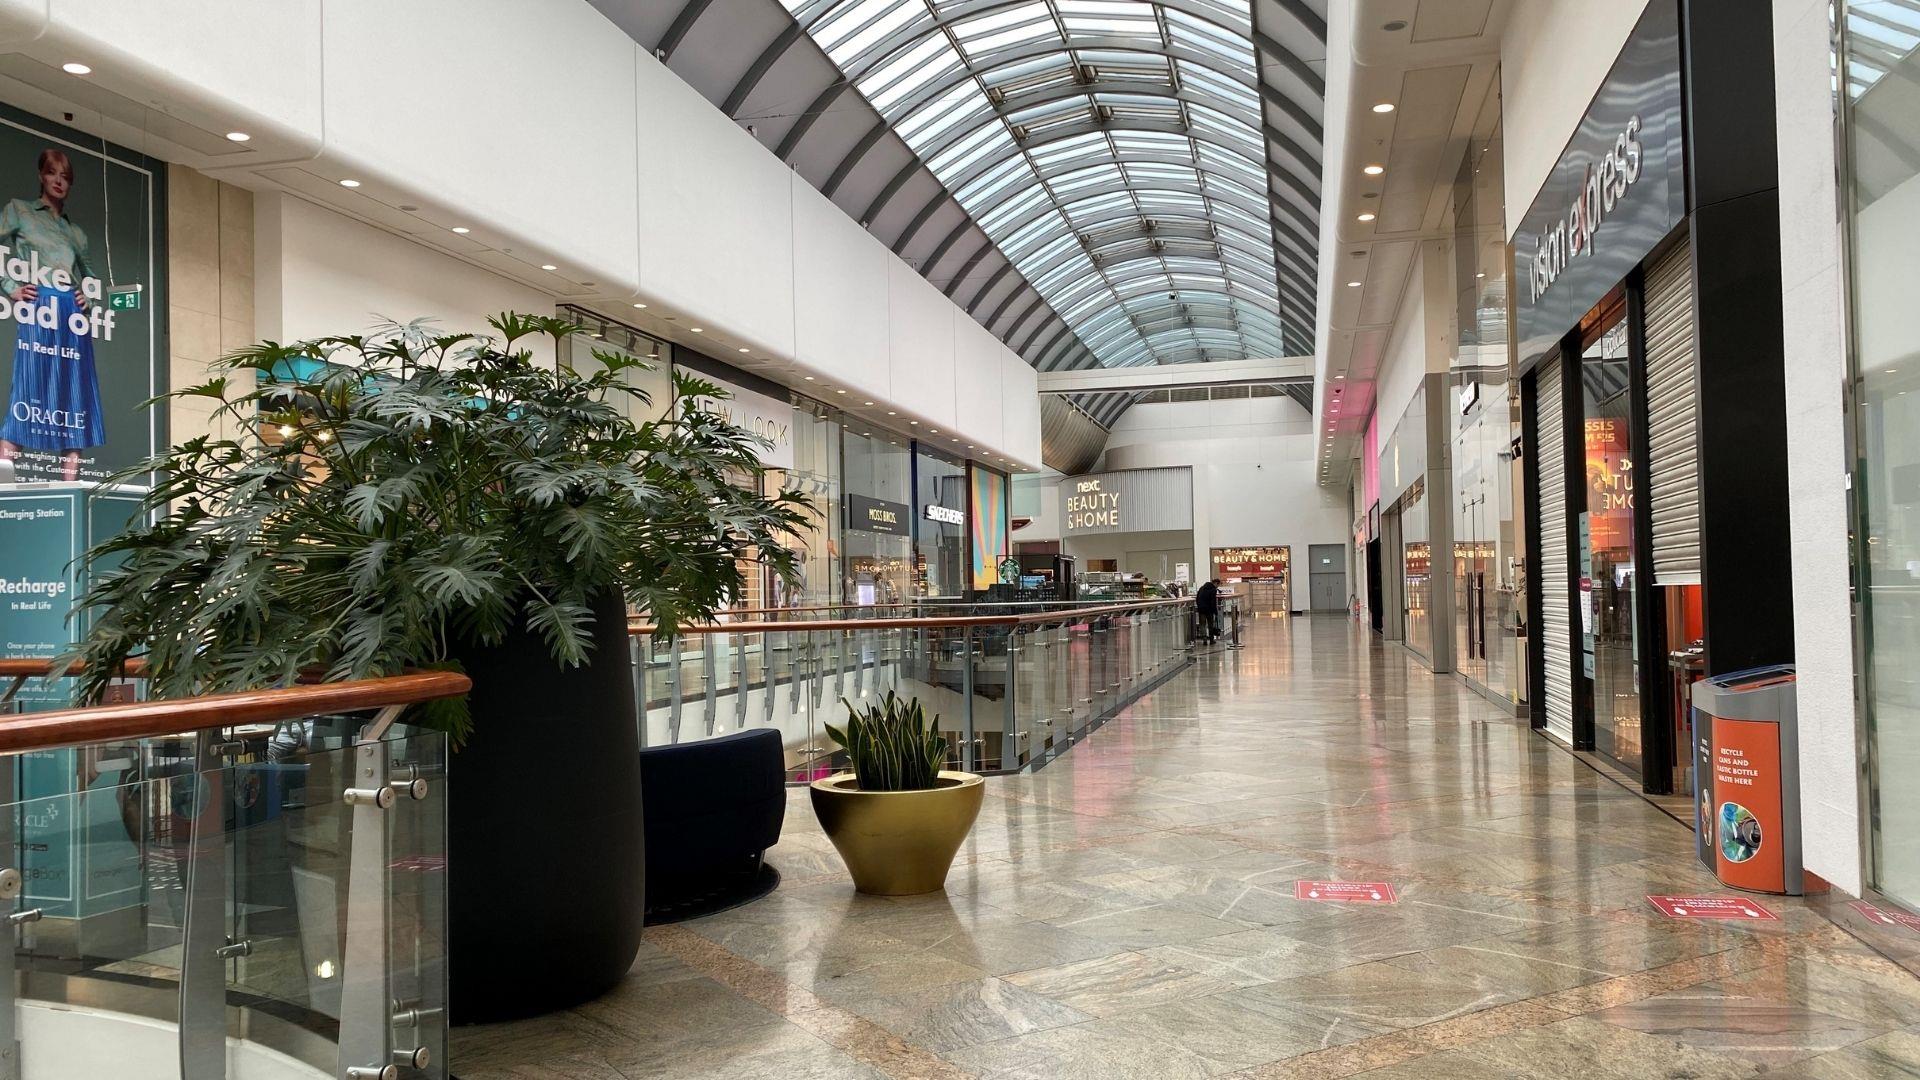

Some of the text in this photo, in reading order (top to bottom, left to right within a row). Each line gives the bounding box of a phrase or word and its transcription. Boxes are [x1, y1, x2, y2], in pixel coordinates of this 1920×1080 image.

[1530, 115, 1642, 304] vision express
[0, 245, 101, 300] Take a
[0, 295, 115, 341] oad off
[18, 339, 81, 360] In Real Life
[13, 401, 86, 429] ORACLE
[31, 428, 74, 438] READING
[3, 448, 21, 458] Bags
[24, 452, 56, 463] weighing
[73, 456, 95, 464] down?
[15, 462, 30, 470] with
[32, 463, 44, 471] the
[45, 465, 78, 474] Customer
[79, 468, 105, 477] Service
[1077, 480, 1101, 493] next
[1067, 492, 1119, 512] BEAUTY
[0, 508, 65, 520] Charging Station
[927, 504, 964, 525] SKECHERS
[1076, 510, 1119, 528] HOME
[1214, 553, 1287, 563] BEAUTY & HOME
[0, 577, 66, 597] Recharge
[20, 601, 36, 610] Real
[38, 601, 52, 610] Life
[1720, 748, 1744, 757] RECYCLE
[1732, 768, 1759, 776] BOTTLE
